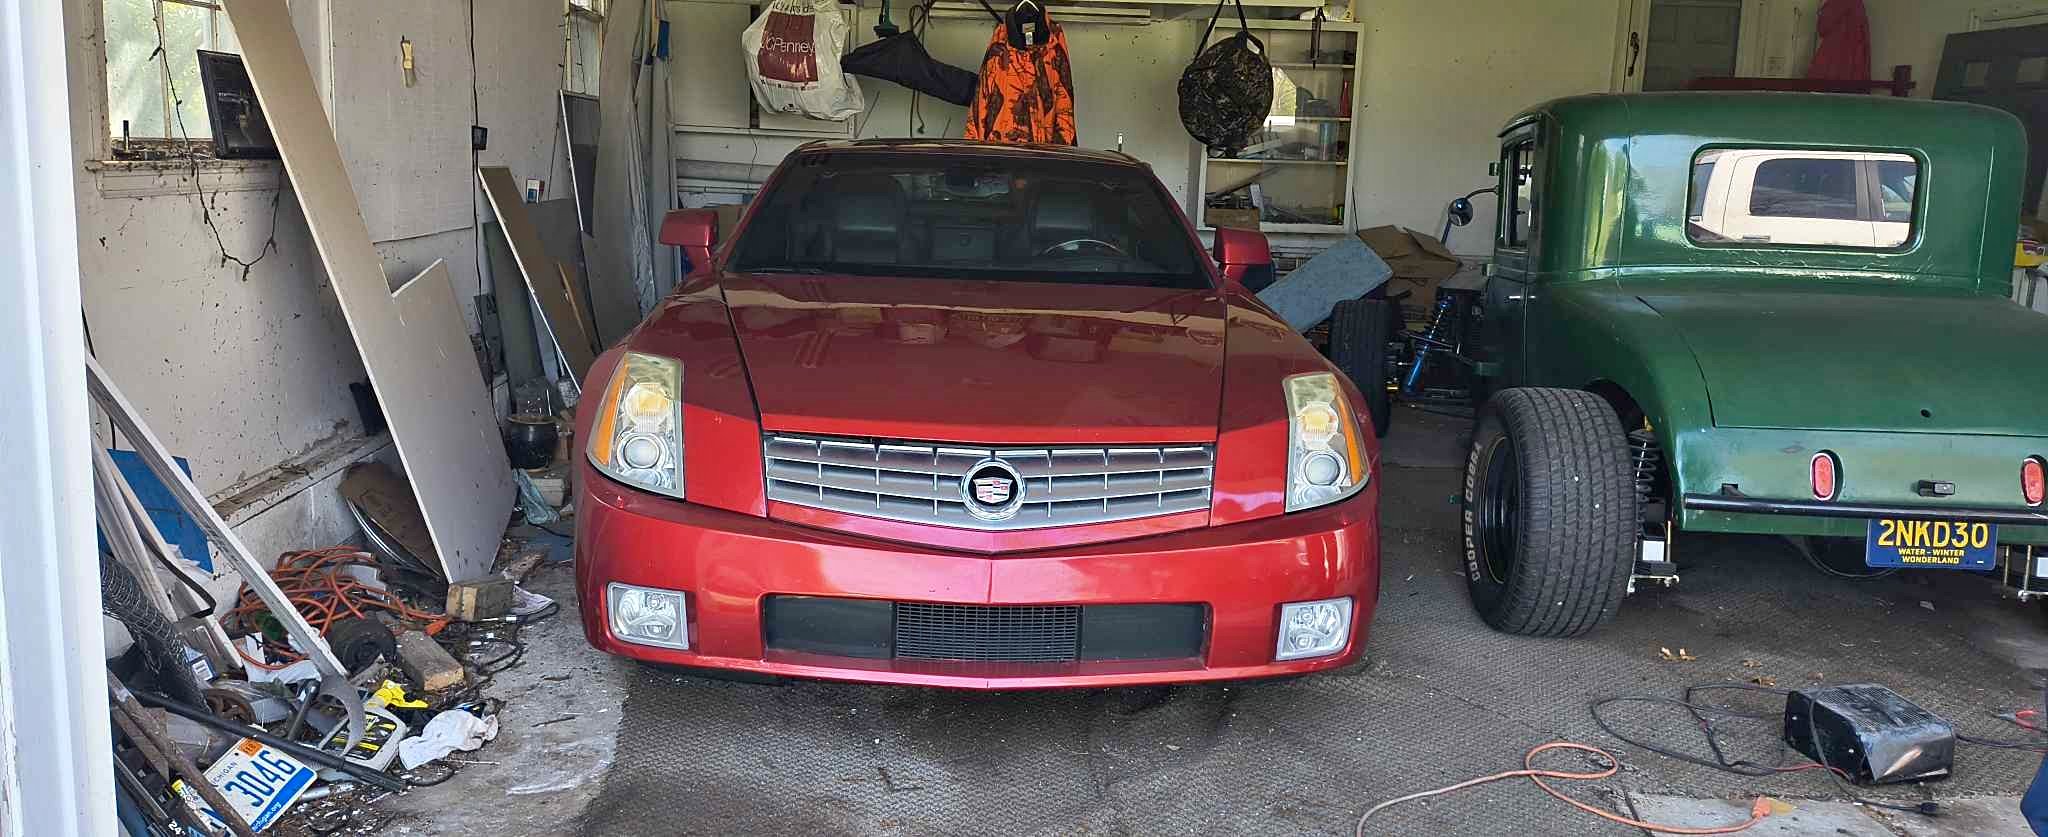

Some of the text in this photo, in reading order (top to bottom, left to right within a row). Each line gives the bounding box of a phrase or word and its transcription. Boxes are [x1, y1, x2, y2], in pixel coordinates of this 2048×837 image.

[1464, 441, 1483, 582] COOPER COBRA
[1877, 519, 1989, 549] 2NKD30
[1898, 547, 1926, 556] WATER
[1932, 548, 1965, 557] WINTER
[1902, 555, 1960, 564] WONDERLAND
[212, 761, 238, 785] ICHIGAN
[224, 749, 297, 808] 3046
